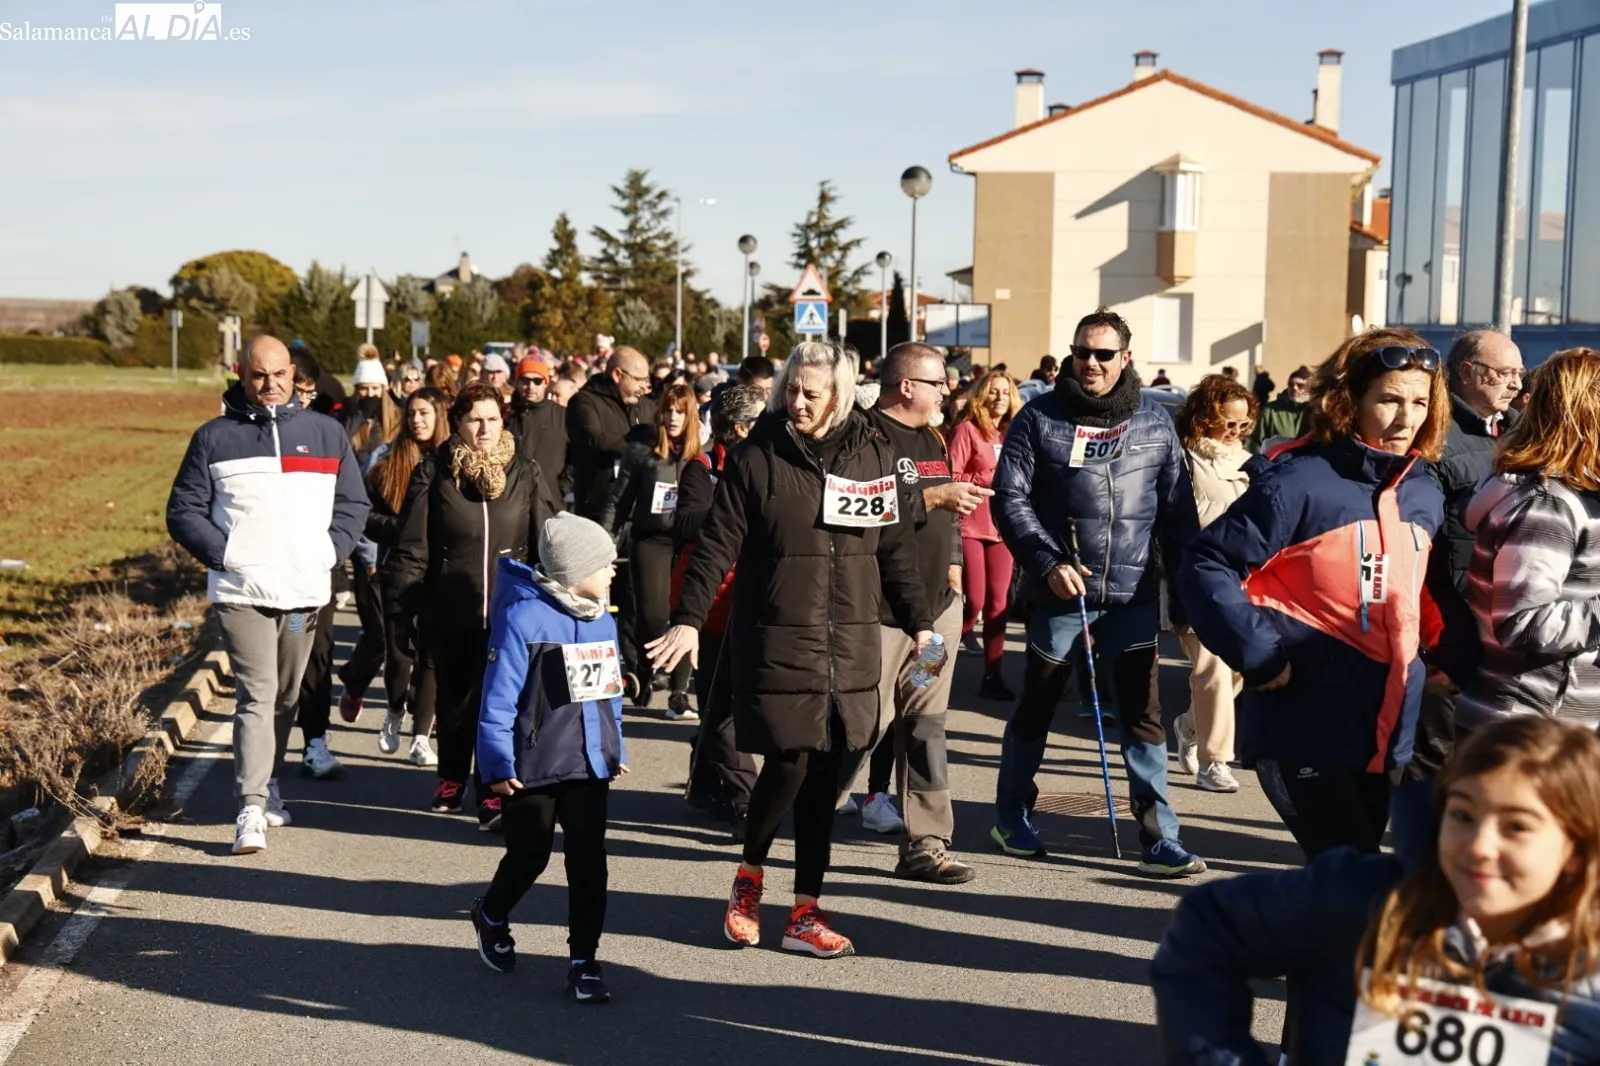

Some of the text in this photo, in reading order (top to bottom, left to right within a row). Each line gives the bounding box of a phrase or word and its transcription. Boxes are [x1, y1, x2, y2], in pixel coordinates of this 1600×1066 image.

[1077, 424, 1128, 440] bedunia
[1084, 437, 1120, 458] 507
[837, 496, 885, 516] 228
[567, 663, 602, 688] 227
[1396, 1009, 1505, 1066] 680
